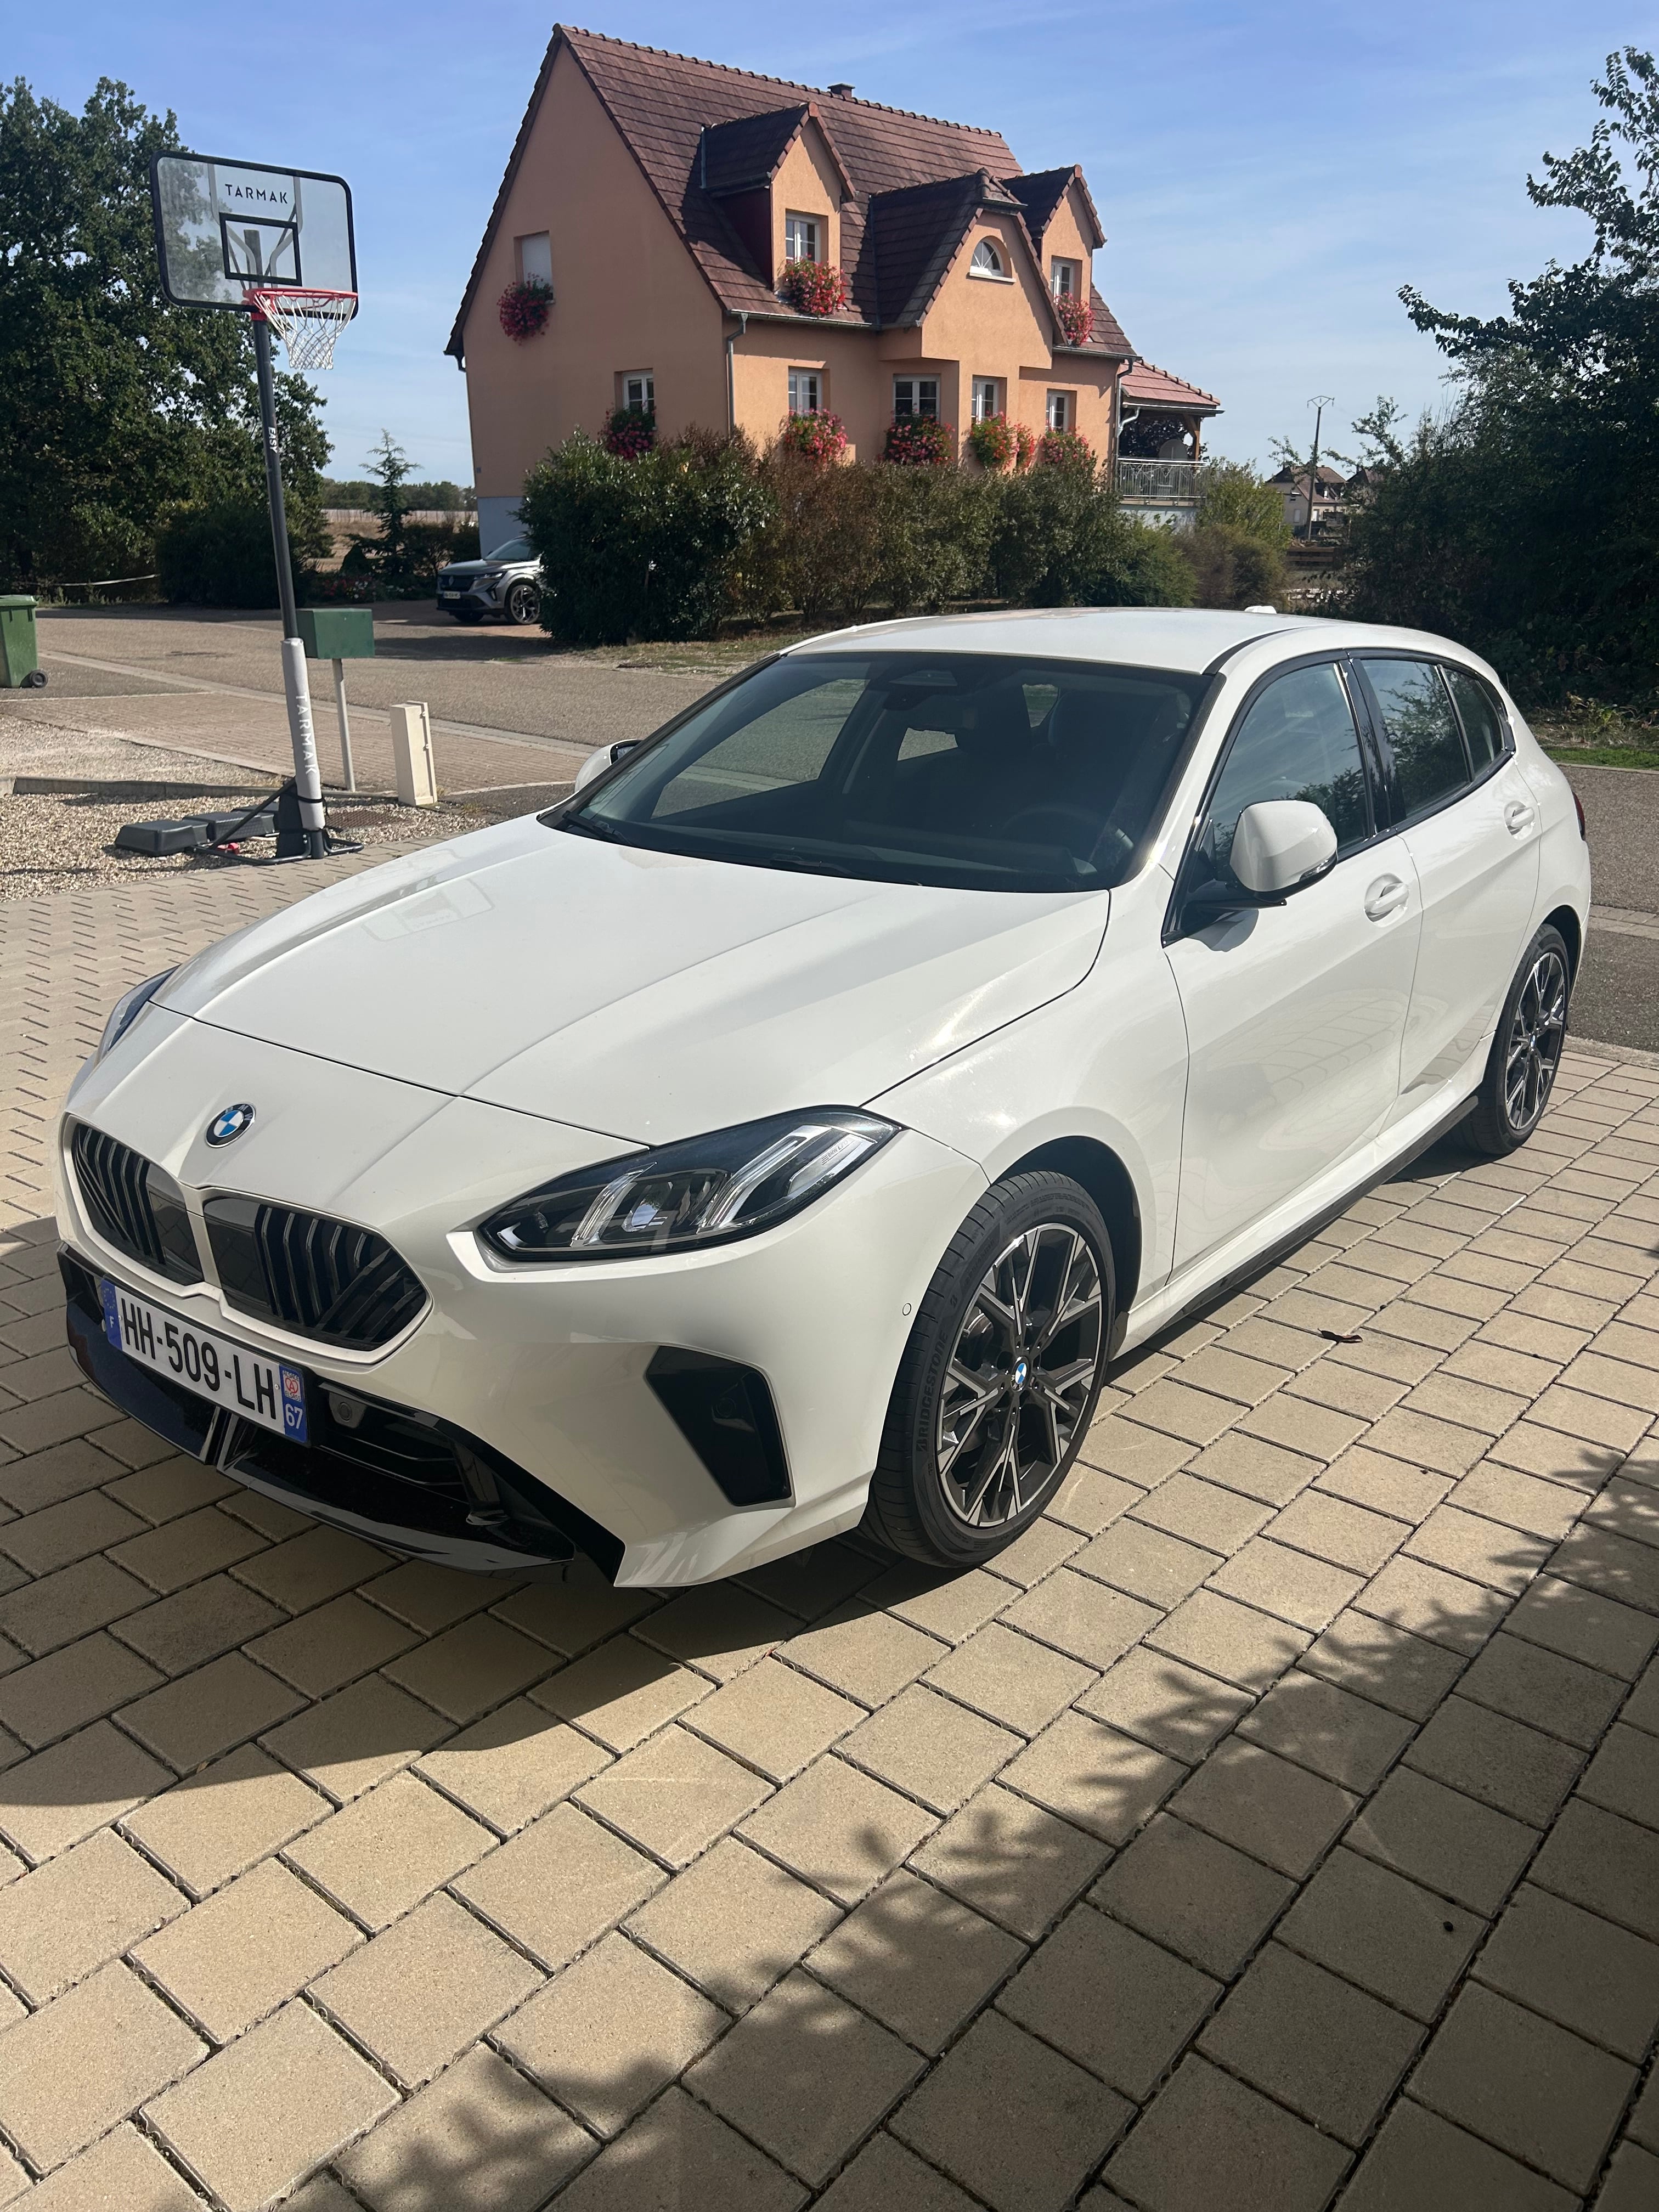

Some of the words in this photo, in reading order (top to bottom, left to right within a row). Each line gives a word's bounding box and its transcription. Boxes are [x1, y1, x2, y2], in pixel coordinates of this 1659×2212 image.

[225, 184, 287, 204] TARMAK
[268, 427, 278, 453] EASY
[296, 692, 317, 774] TARMAK
[109, 1316, 114, 1328] F
[121, 1297, 276, 1420] HH-509-LH
[916, 1330, 948, 1451] BRIDGESTONE
[285, 1403, 303, 1429] 67
